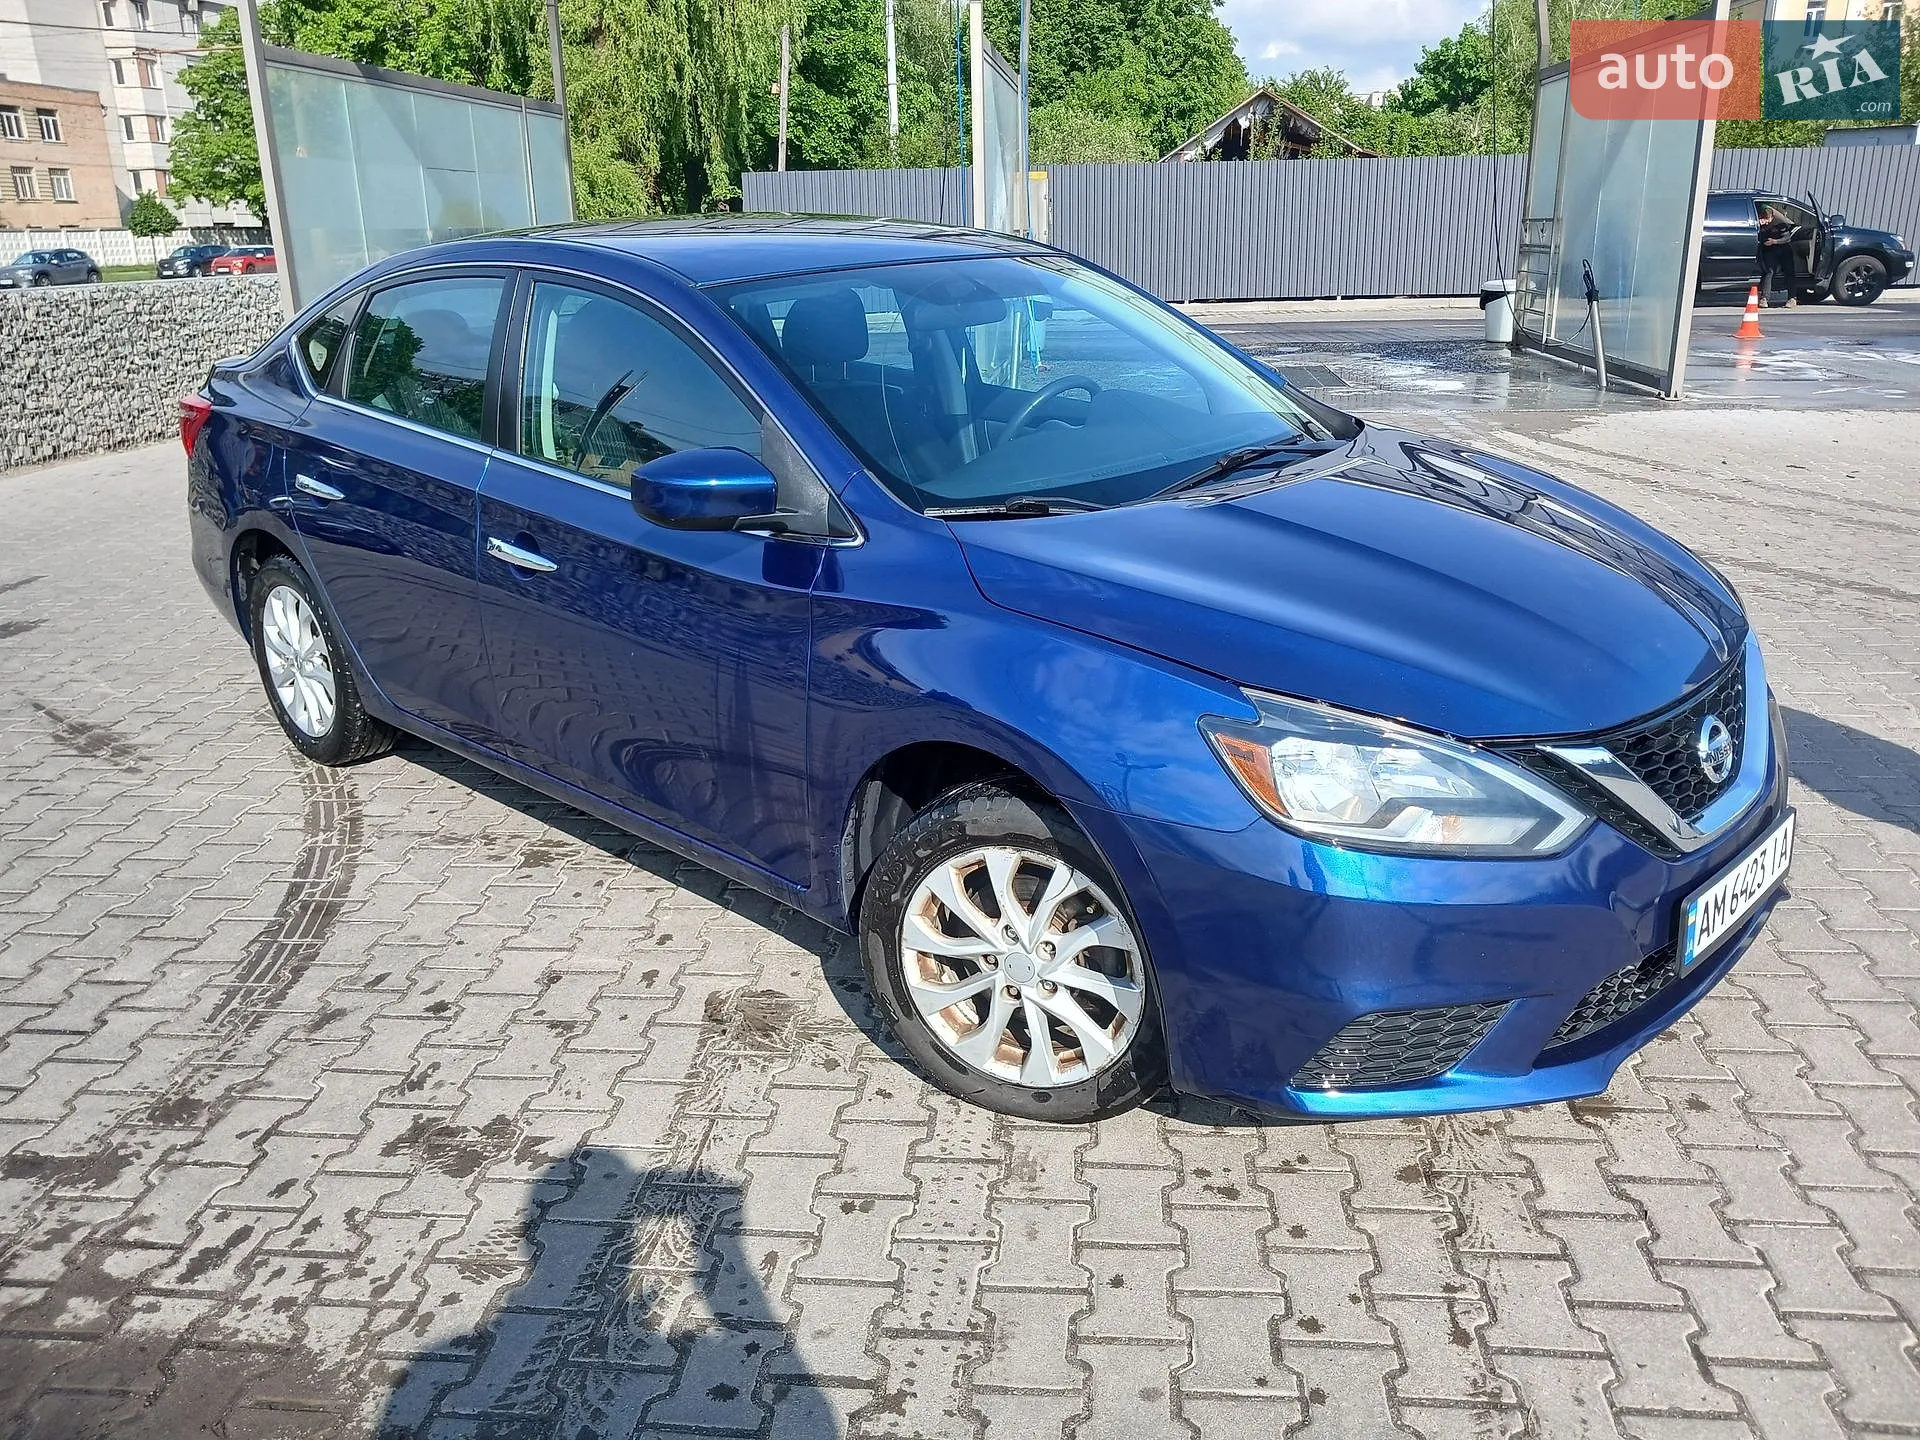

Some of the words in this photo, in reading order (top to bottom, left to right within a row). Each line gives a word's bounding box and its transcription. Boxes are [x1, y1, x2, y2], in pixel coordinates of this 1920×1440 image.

[1697, 884, 1728, 946] AM
[1730, 848, 1767, 915] 6423
[1771, 827, 1788, 875] IA
